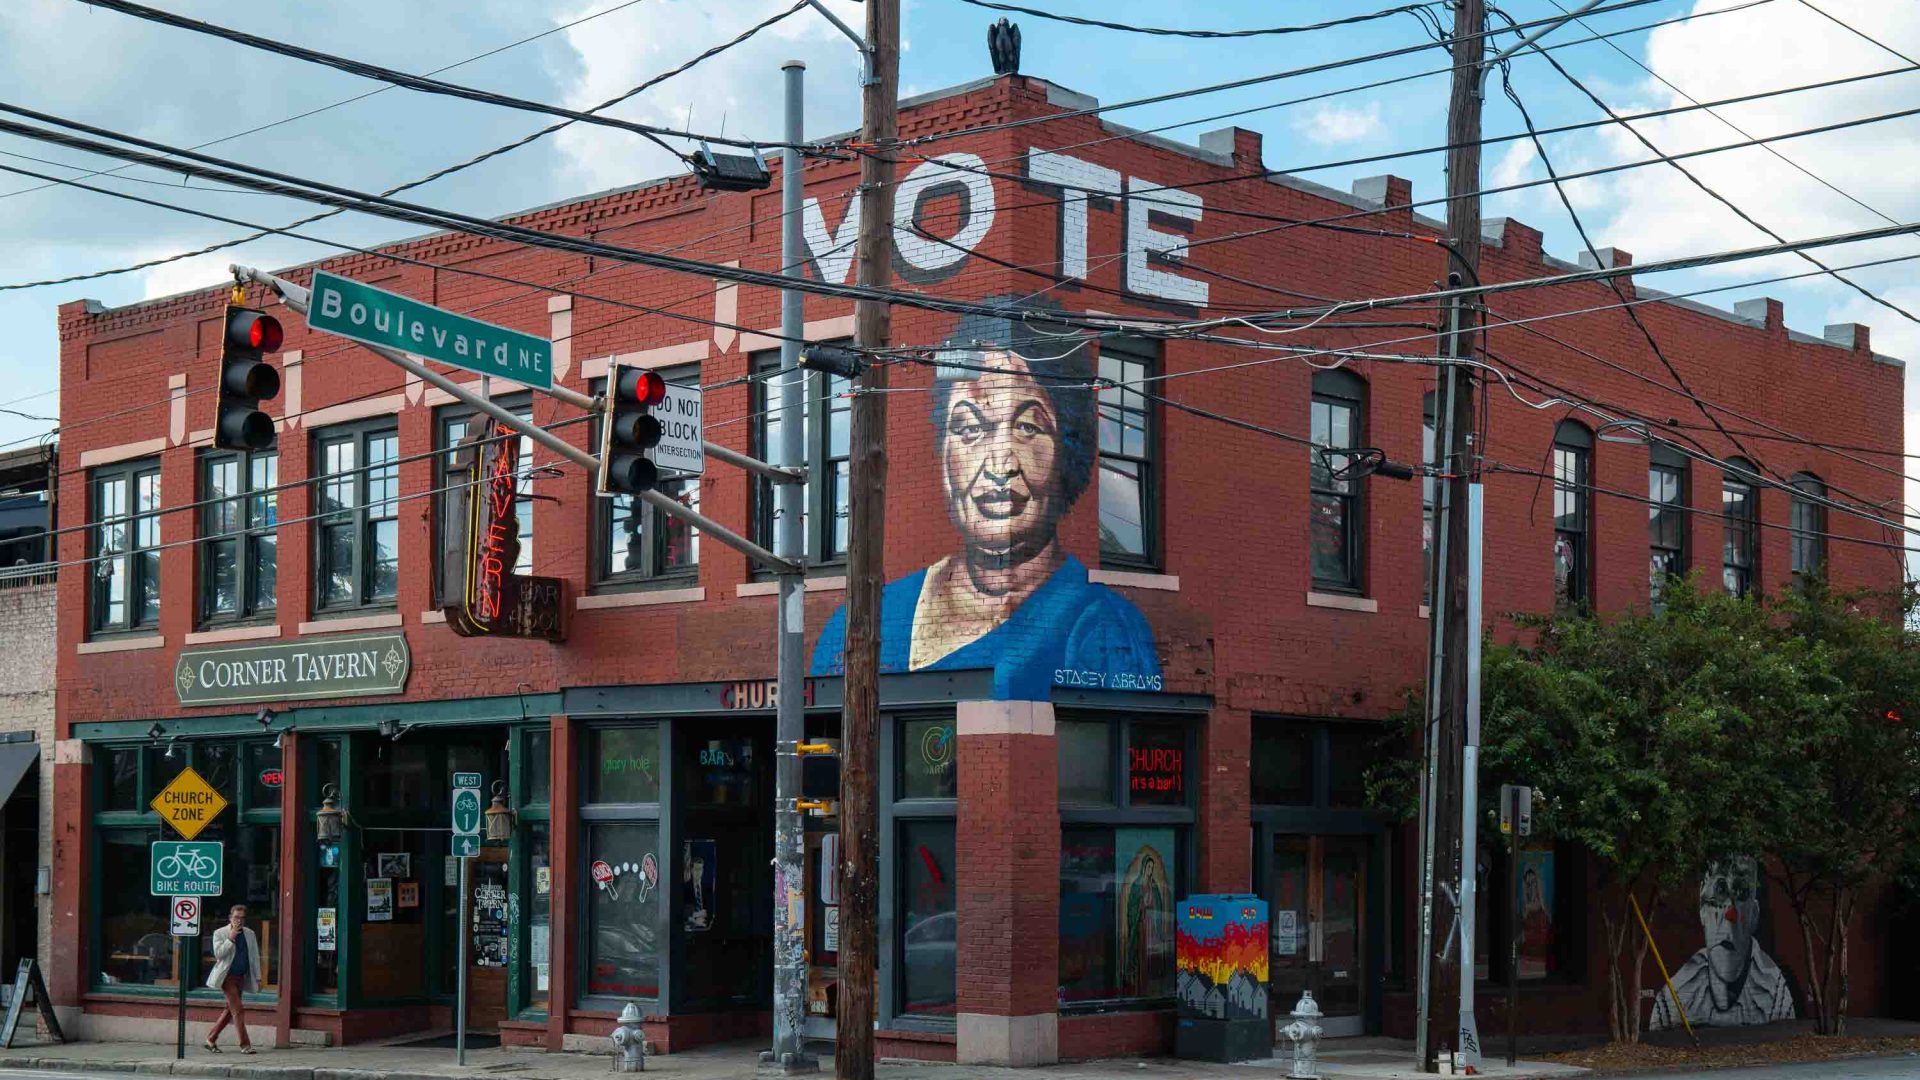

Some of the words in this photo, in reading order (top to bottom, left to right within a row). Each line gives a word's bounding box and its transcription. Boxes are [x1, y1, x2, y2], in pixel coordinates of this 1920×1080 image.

[801, 146, 1209, 308] VOTE
[321, 288, 508, 366] Boulevard
[518, 348, 543, 372] NE
[678, 398, 700, 418] NOT
[659, 420, 698, 441] BLOCK
[657, 445, 701, 460] INTERSECTION
[481, 425, 517, 619] TAVERN
[200, 659, 288, 689] CORNER
[292, 651, 378, 683] TAVERN
[1054, 669, 1107, 688] STACEY
[1111, 672, 1162, 691] ABRAMS
[720, 681, 814, 709] CHURH
[700, 750, 724, 766] BAR
[261, 771, 283, 785] OPEN
[458, 775, 477, 786] WEST
[164, 791, 213, 805] CHURCH
[172, 808, 204, 821] ZONE
[464, 813, 469, 830] 1
[157, 880, 180, 892] BIKE
